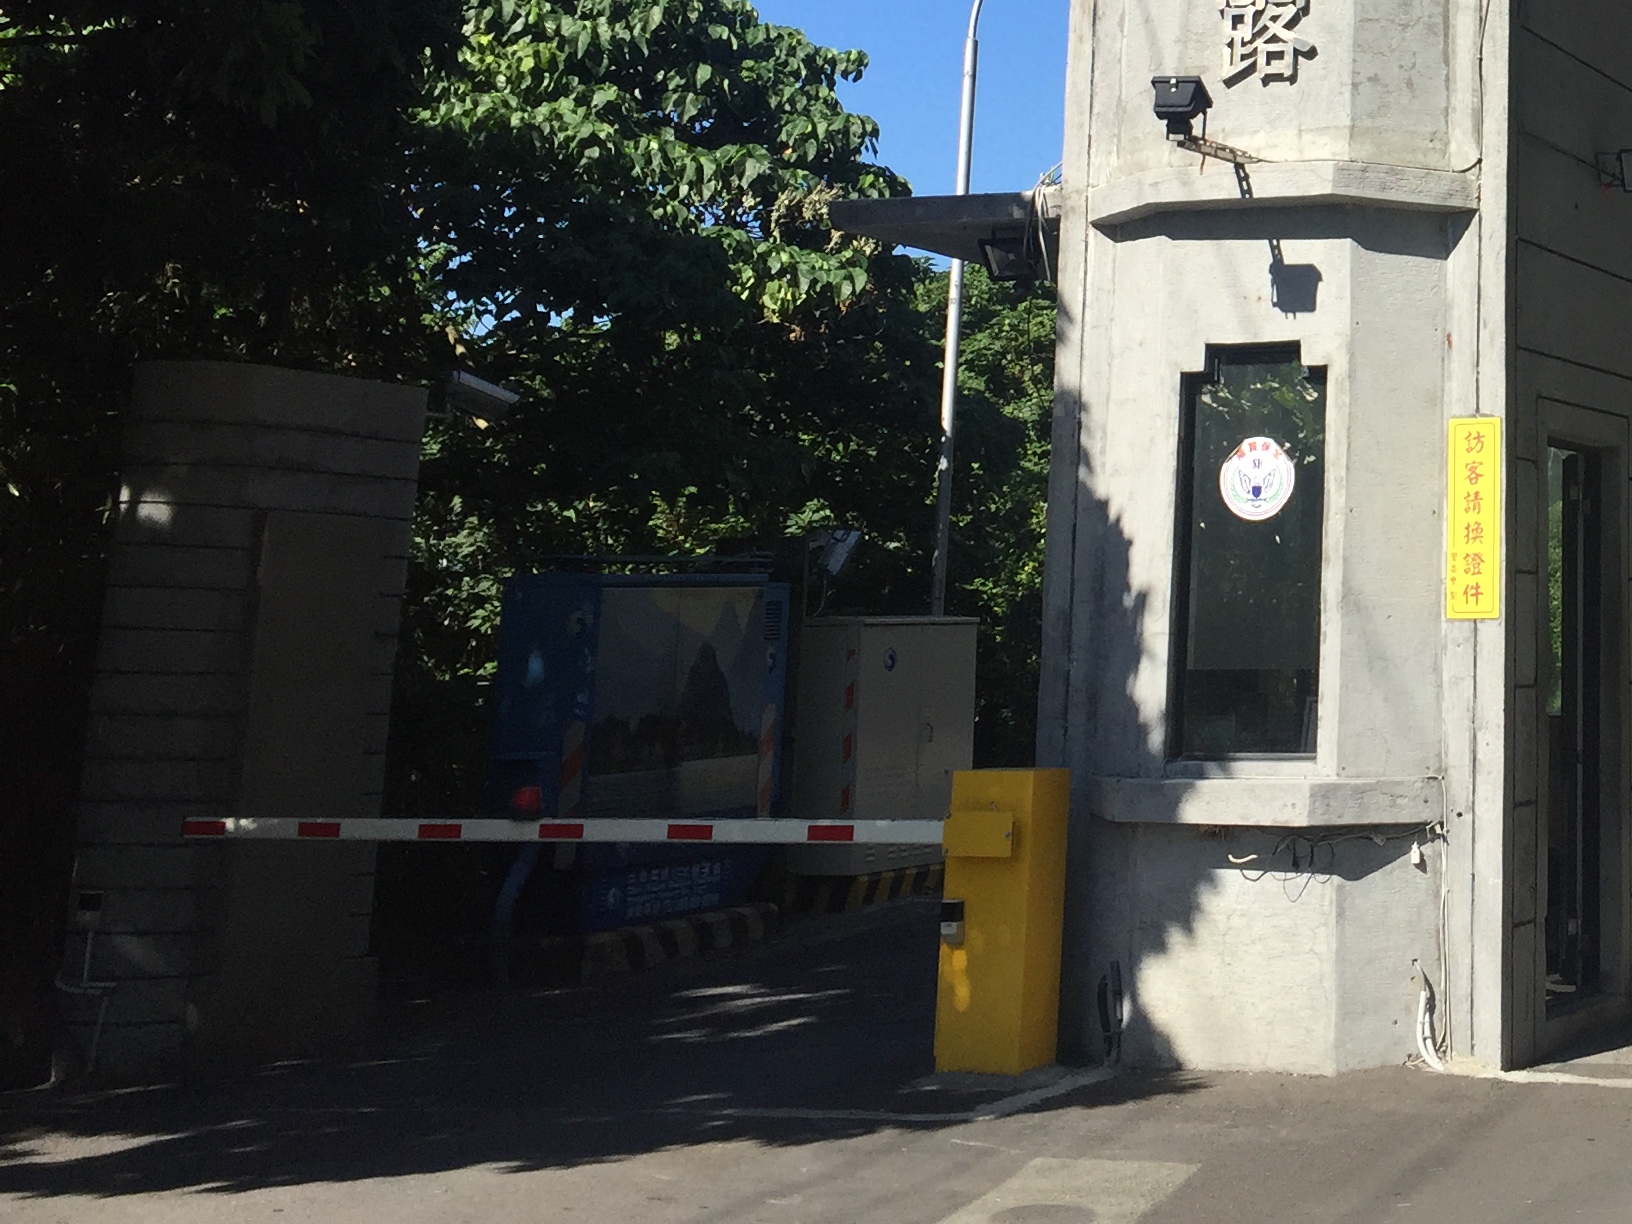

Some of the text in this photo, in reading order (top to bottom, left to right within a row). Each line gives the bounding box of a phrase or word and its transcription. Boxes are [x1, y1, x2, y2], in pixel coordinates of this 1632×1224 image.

[1462, 430, 1486, 607] 訪客請換證件
